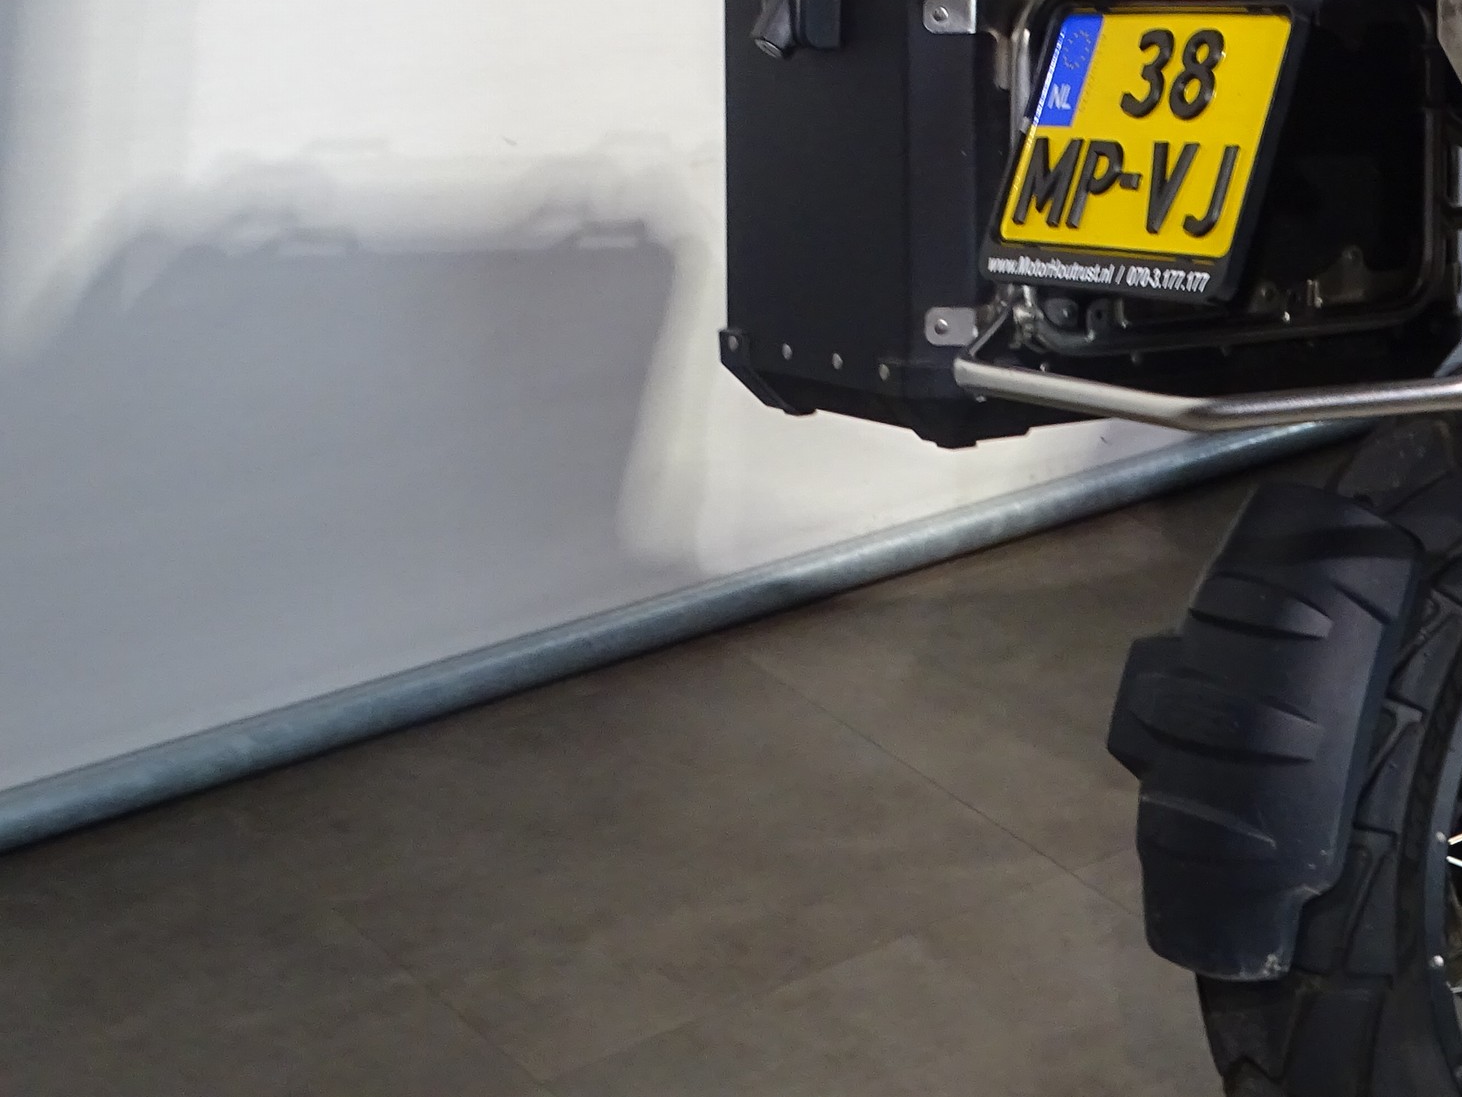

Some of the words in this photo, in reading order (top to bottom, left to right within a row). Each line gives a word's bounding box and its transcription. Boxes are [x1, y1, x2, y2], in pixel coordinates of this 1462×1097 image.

[1047, 83, 1072, 110] NL
[1120, 28, 1225, 120] 38
[1011, 137, 1240, 239] MP-VJ
[1127, 266, 1210, 293] 070-3.177.177
